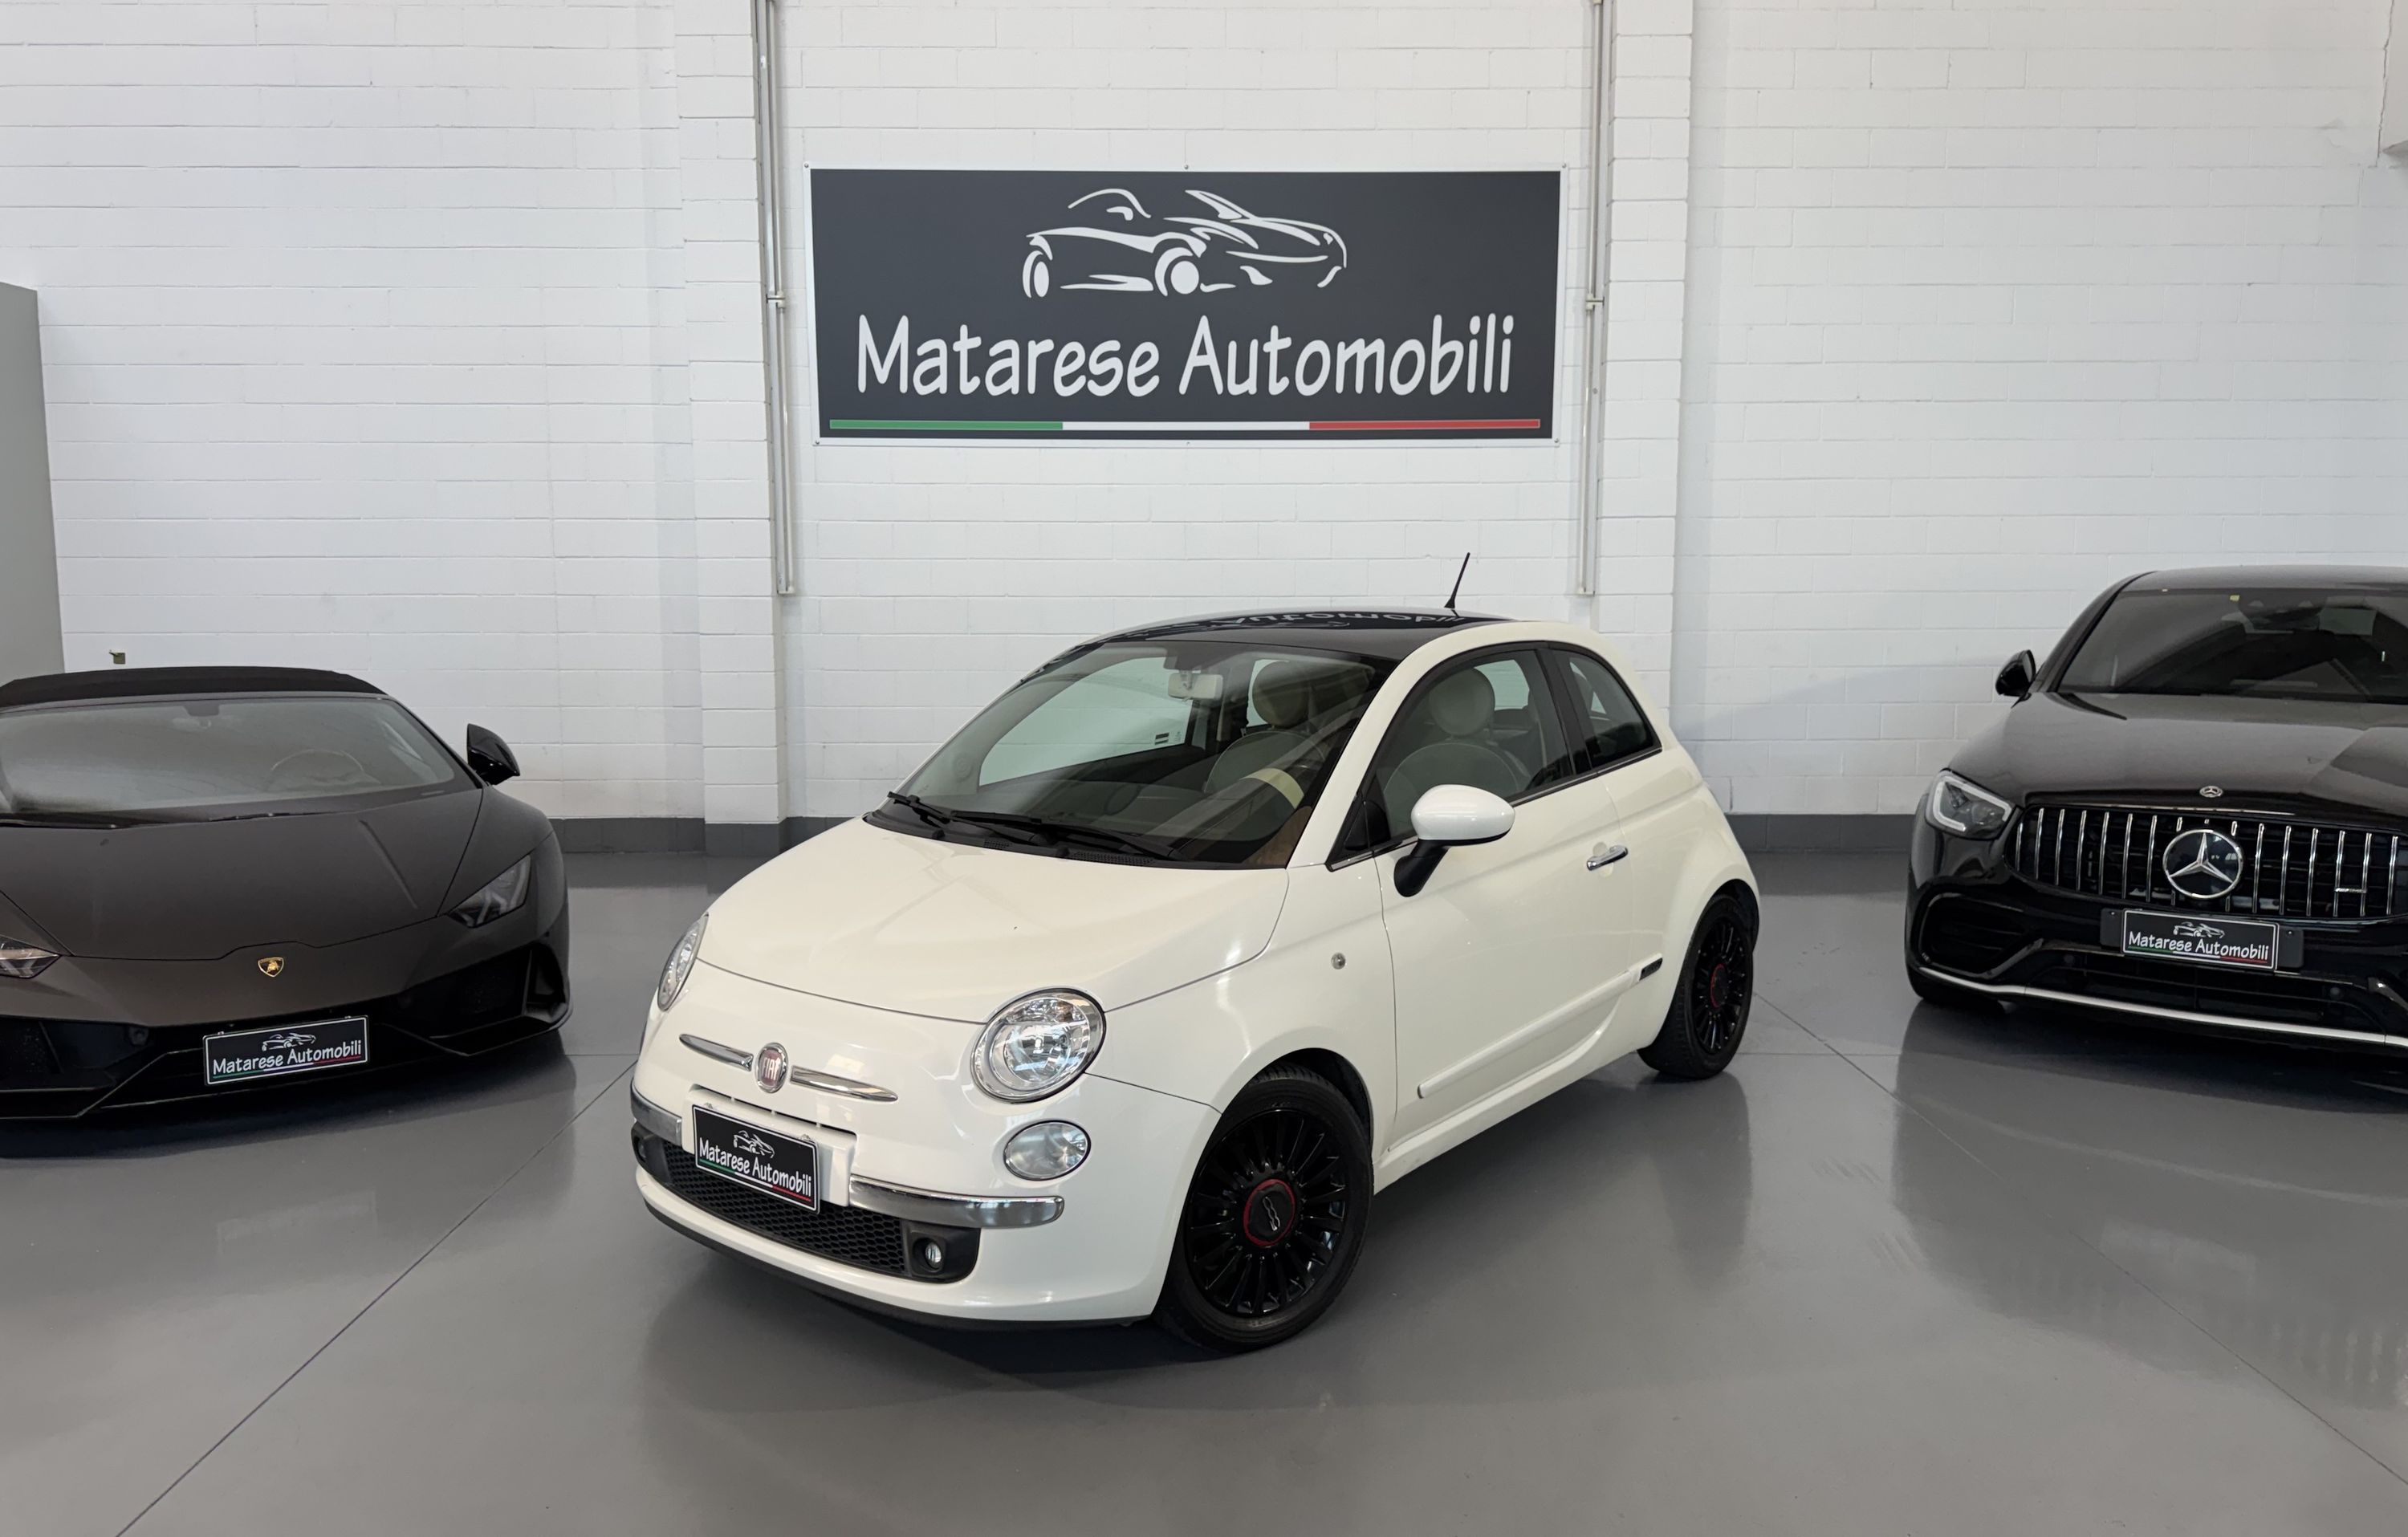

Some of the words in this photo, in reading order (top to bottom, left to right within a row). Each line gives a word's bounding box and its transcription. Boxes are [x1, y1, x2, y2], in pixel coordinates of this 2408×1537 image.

[857, 314, 1161, 396] Matarese
[1179, 313, 1515, 396] Automobili
[2128, 931, 2192, 952] Matarese
[2195, 938, 2269, 960] Automobili
[213, 1055, 284, 1075] Matarese
[287, 1040, 362, 1064] Automobili
[763, 1056, 781, 1080] FIAT
[699, 1137, 750, 1174] Matarese
[752, 1157, 812, 1197] Automobili
